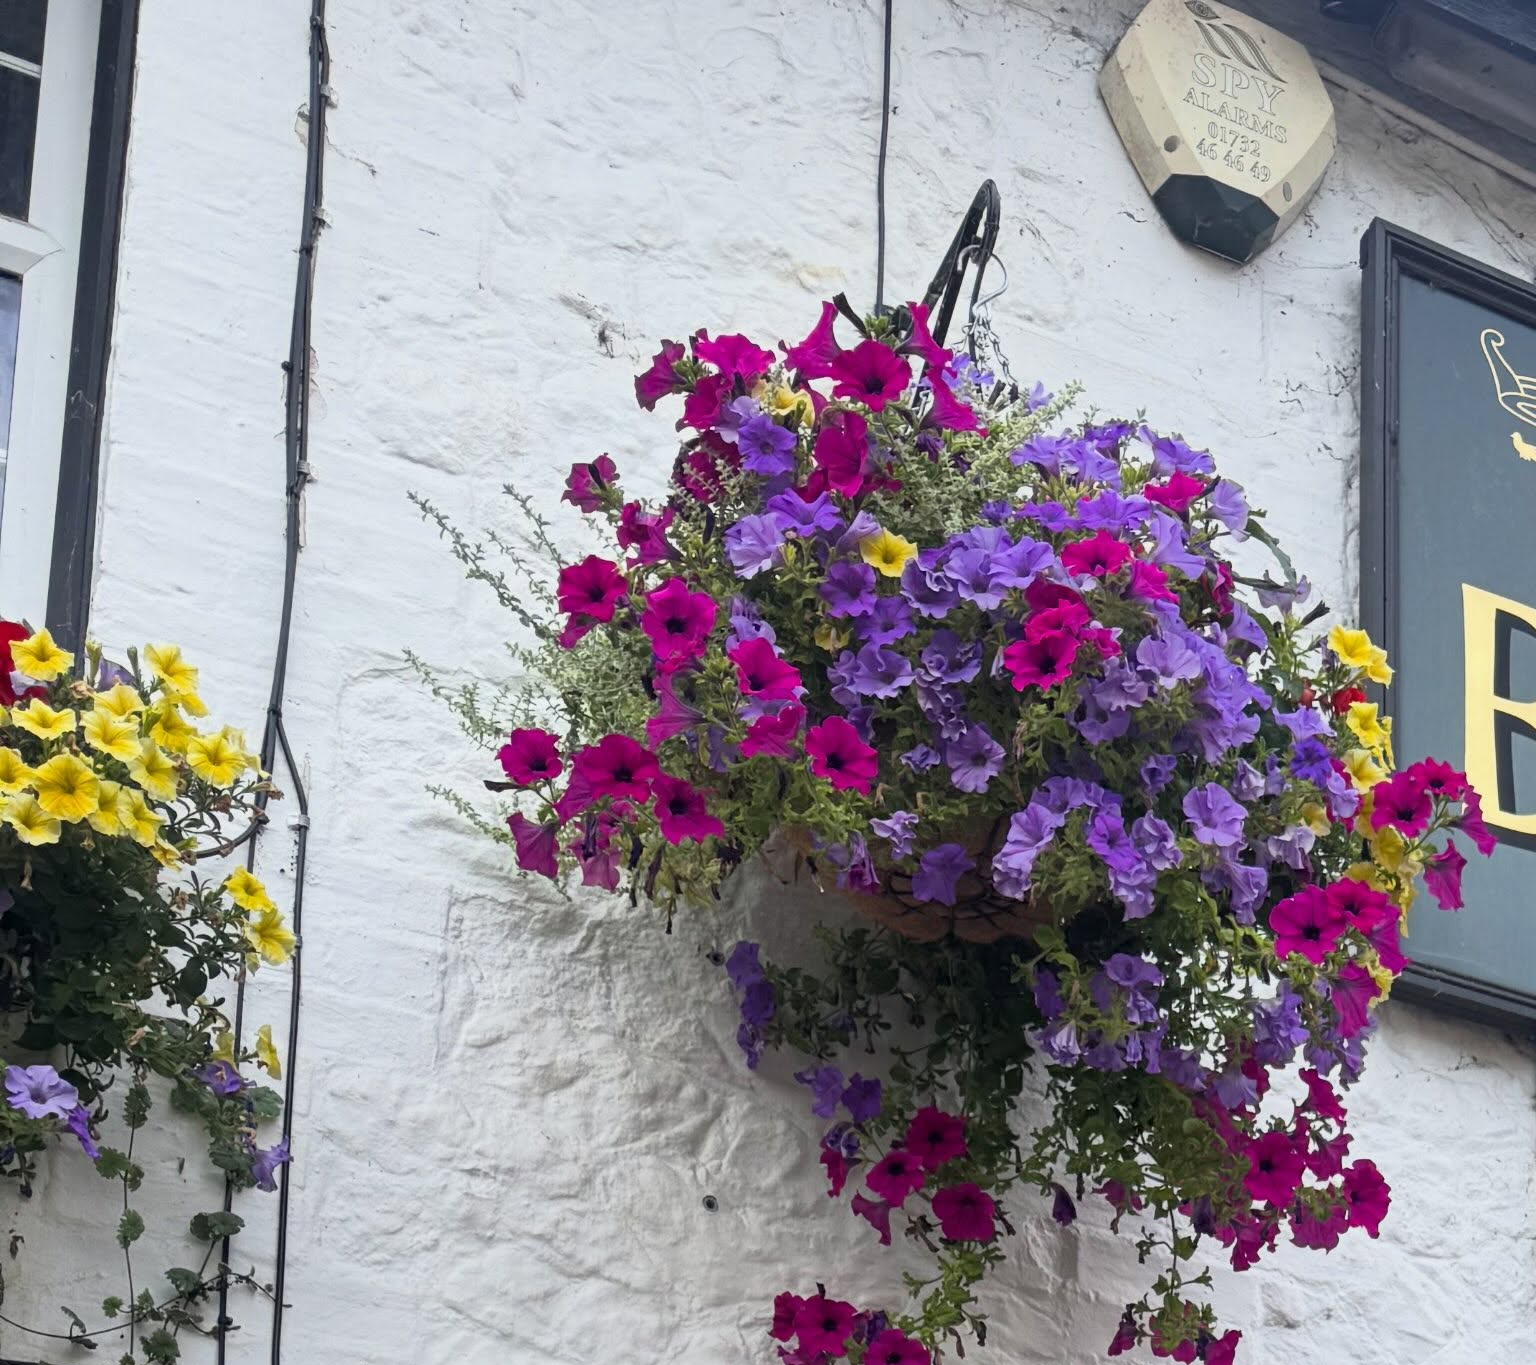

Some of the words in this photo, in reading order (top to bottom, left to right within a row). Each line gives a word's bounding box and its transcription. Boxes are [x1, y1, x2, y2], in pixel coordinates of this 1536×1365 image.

[1191, 53, 1285, 116] SPY
[1182, 87, 1288, 144] ALARMS
[1207, 121, 1261, 158] 01732
